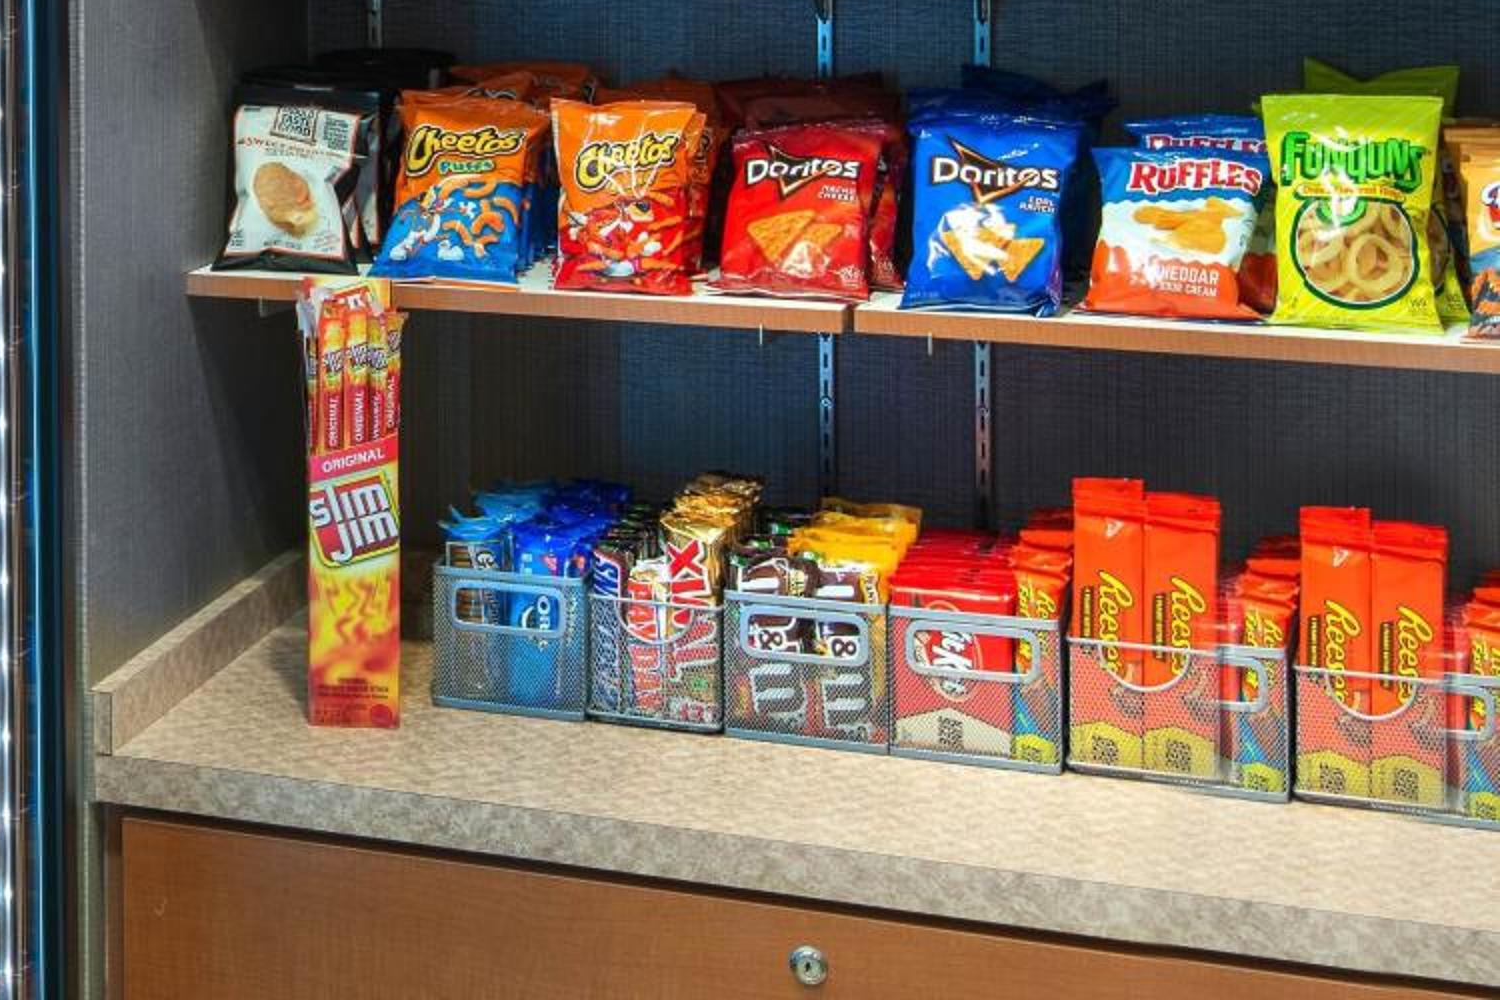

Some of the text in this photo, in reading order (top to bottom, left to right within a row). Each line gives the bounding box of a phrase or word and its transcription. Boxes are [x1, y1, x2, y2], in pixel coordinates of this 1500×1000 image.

[407, 127, 524, 175] Cheetos
[577, 135, 680, 189] Cheetos
[746, 159, 861, 186] Doritos
[932, 157, 1060, 190] Doritos
[1128, 159, 1263, 196] RUFFLES
[1152, 262, 1220, 285] HEDDAR
[321, 448, 386, 473] ORIGINAL
